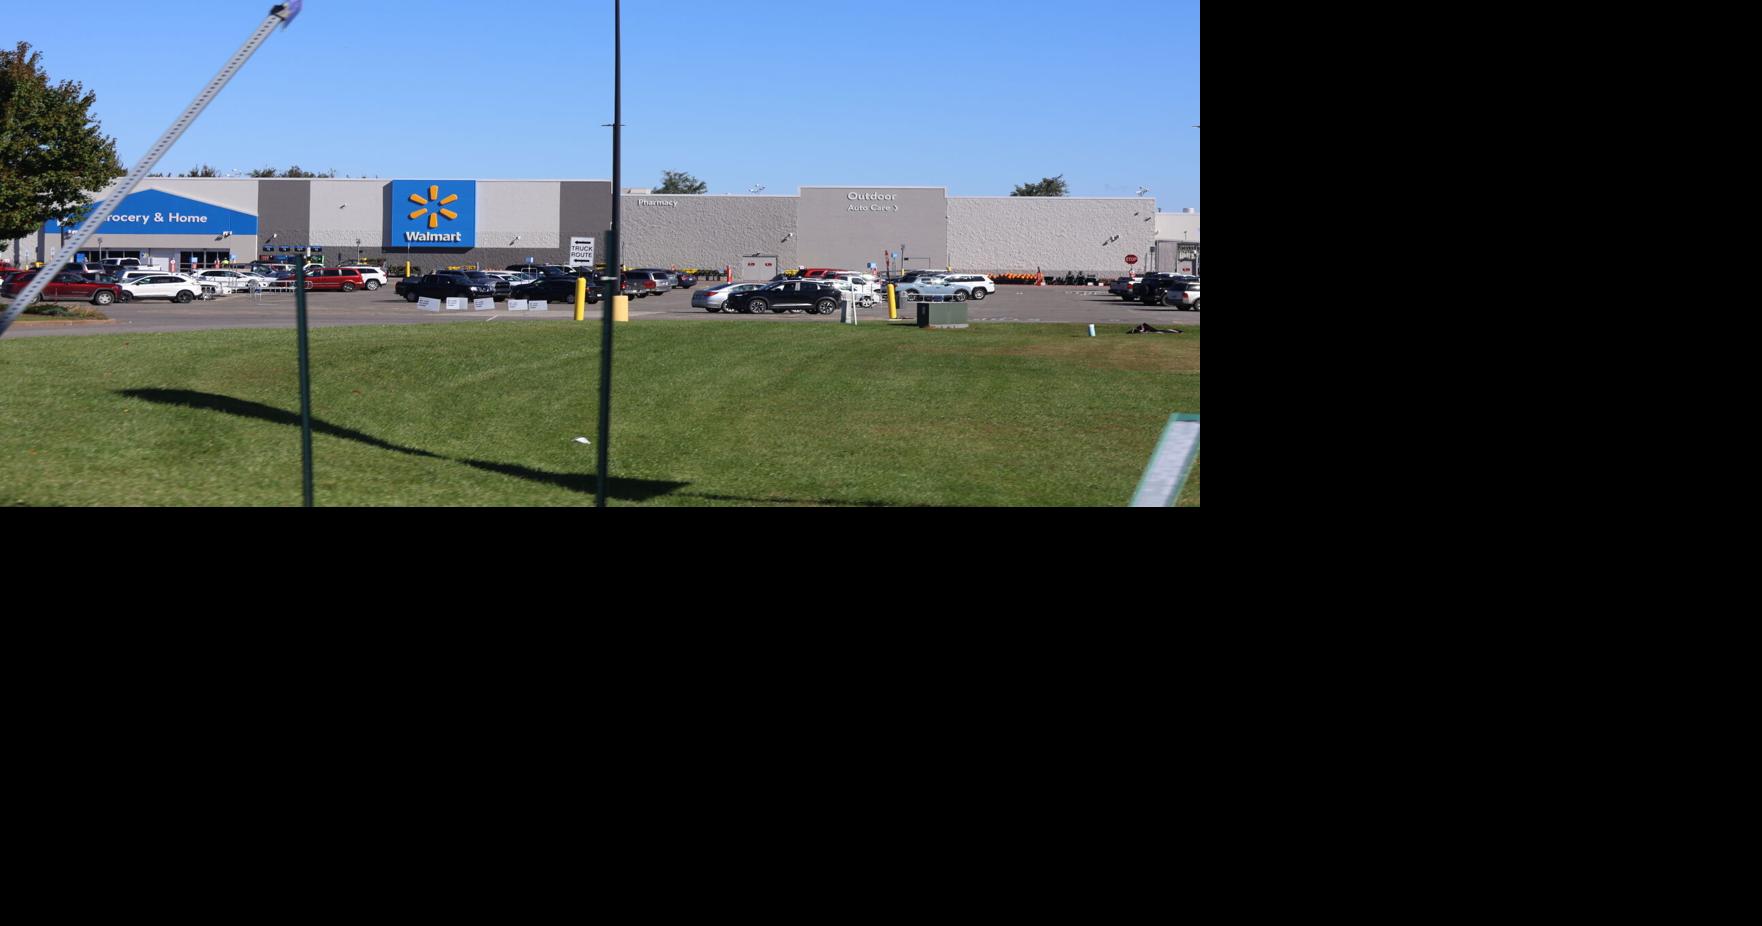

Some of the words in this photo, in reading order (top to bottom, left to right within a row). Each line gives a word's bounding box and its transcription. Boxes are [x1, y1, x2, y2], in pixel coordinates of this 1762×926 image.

[847, 191, 896, 200] Outdoor
[638, 198, 678, 208] Pharmacy
[847, 204, 868, 212] Auto
[103, 214, 149, 225] rocery
[154, 213, 165, 223] &
[169, 213, 208, 223] Home
[405, 231, 462, 242] Walmart
